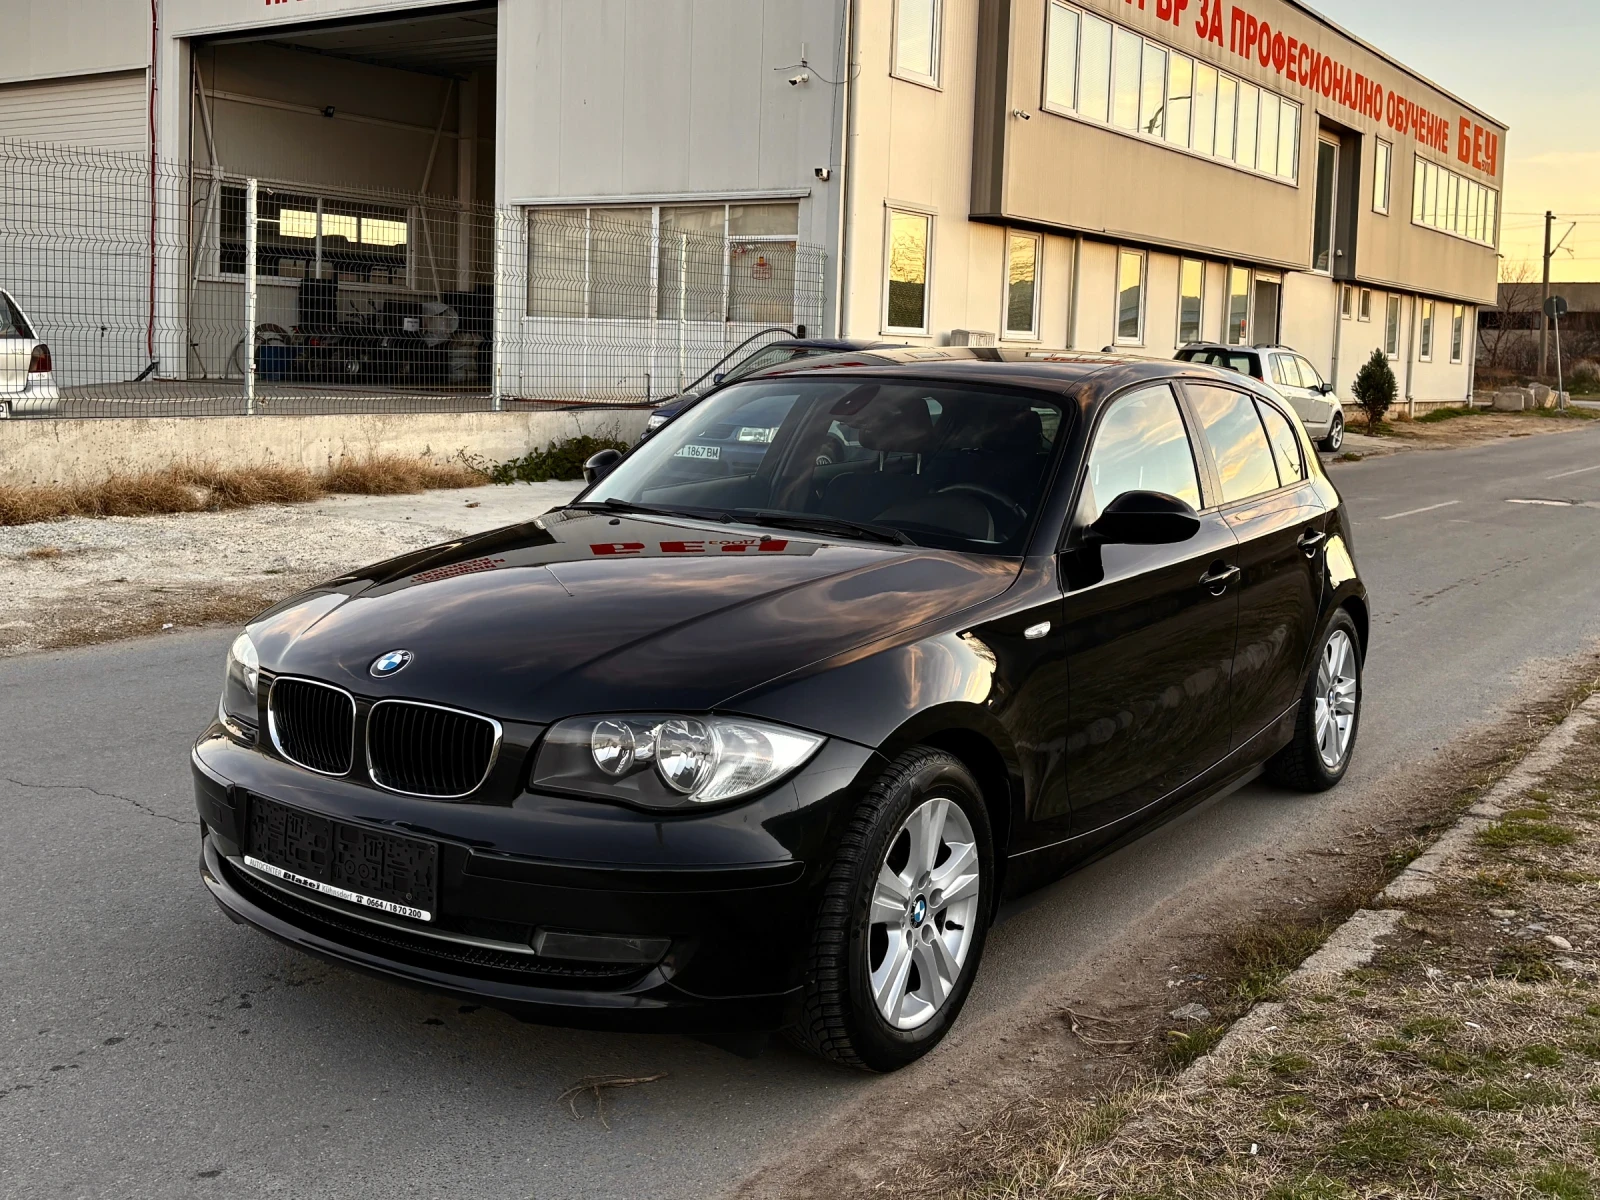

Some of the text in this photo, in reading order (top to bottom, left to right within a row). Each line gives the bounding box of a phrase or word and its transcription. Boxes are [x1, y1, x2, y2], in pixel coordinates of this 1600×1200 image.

[1195, 0, 1224, 47] ЗА
[1230, 5, 1383, 122] ПРОФЕСИОНАЛНО
[1387, 90, 1449, 155] ОБУЧЕНИЕ
[1458, 115, 1498, 177] БЕЧ
[687, 446, 706, 457] 1867
[249, 858, 282, 877] AUTOCENTER
[321, 884, 353, 900] Kühnsdorf
[366, 897, 384, 909] 0664
[408, 908, 422, 919] 200
